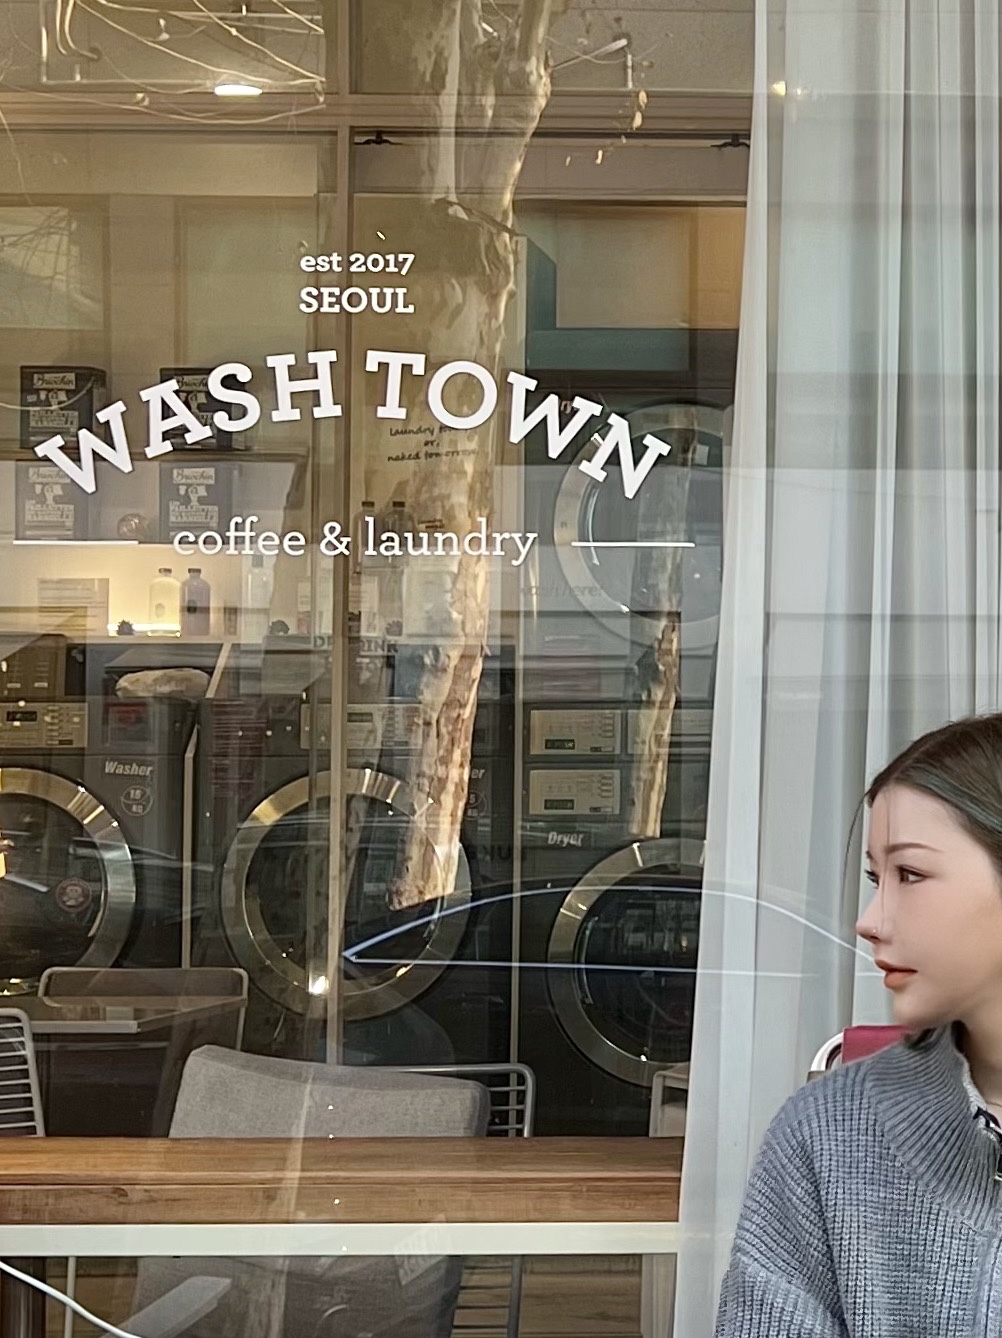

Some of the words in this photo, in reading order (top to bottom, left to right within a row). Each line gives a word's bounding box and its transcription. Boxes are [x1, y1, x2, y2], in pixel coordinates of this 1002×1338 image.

[300, 252, 342, 272] est
[349, 253, 415, 276] 2017
[299, 286, 415, 313] SEOUL
[34, 350, 342, 494] WASH
[365, 349, 672, 500] TOWN
[173, 516, 306, 556] coffee
[319, 521, 351, 556] &
[364, 517, 538, 566] laundry
[104, 760, 153, 776] Washer
[547, 831, 584, 847] Dryer
